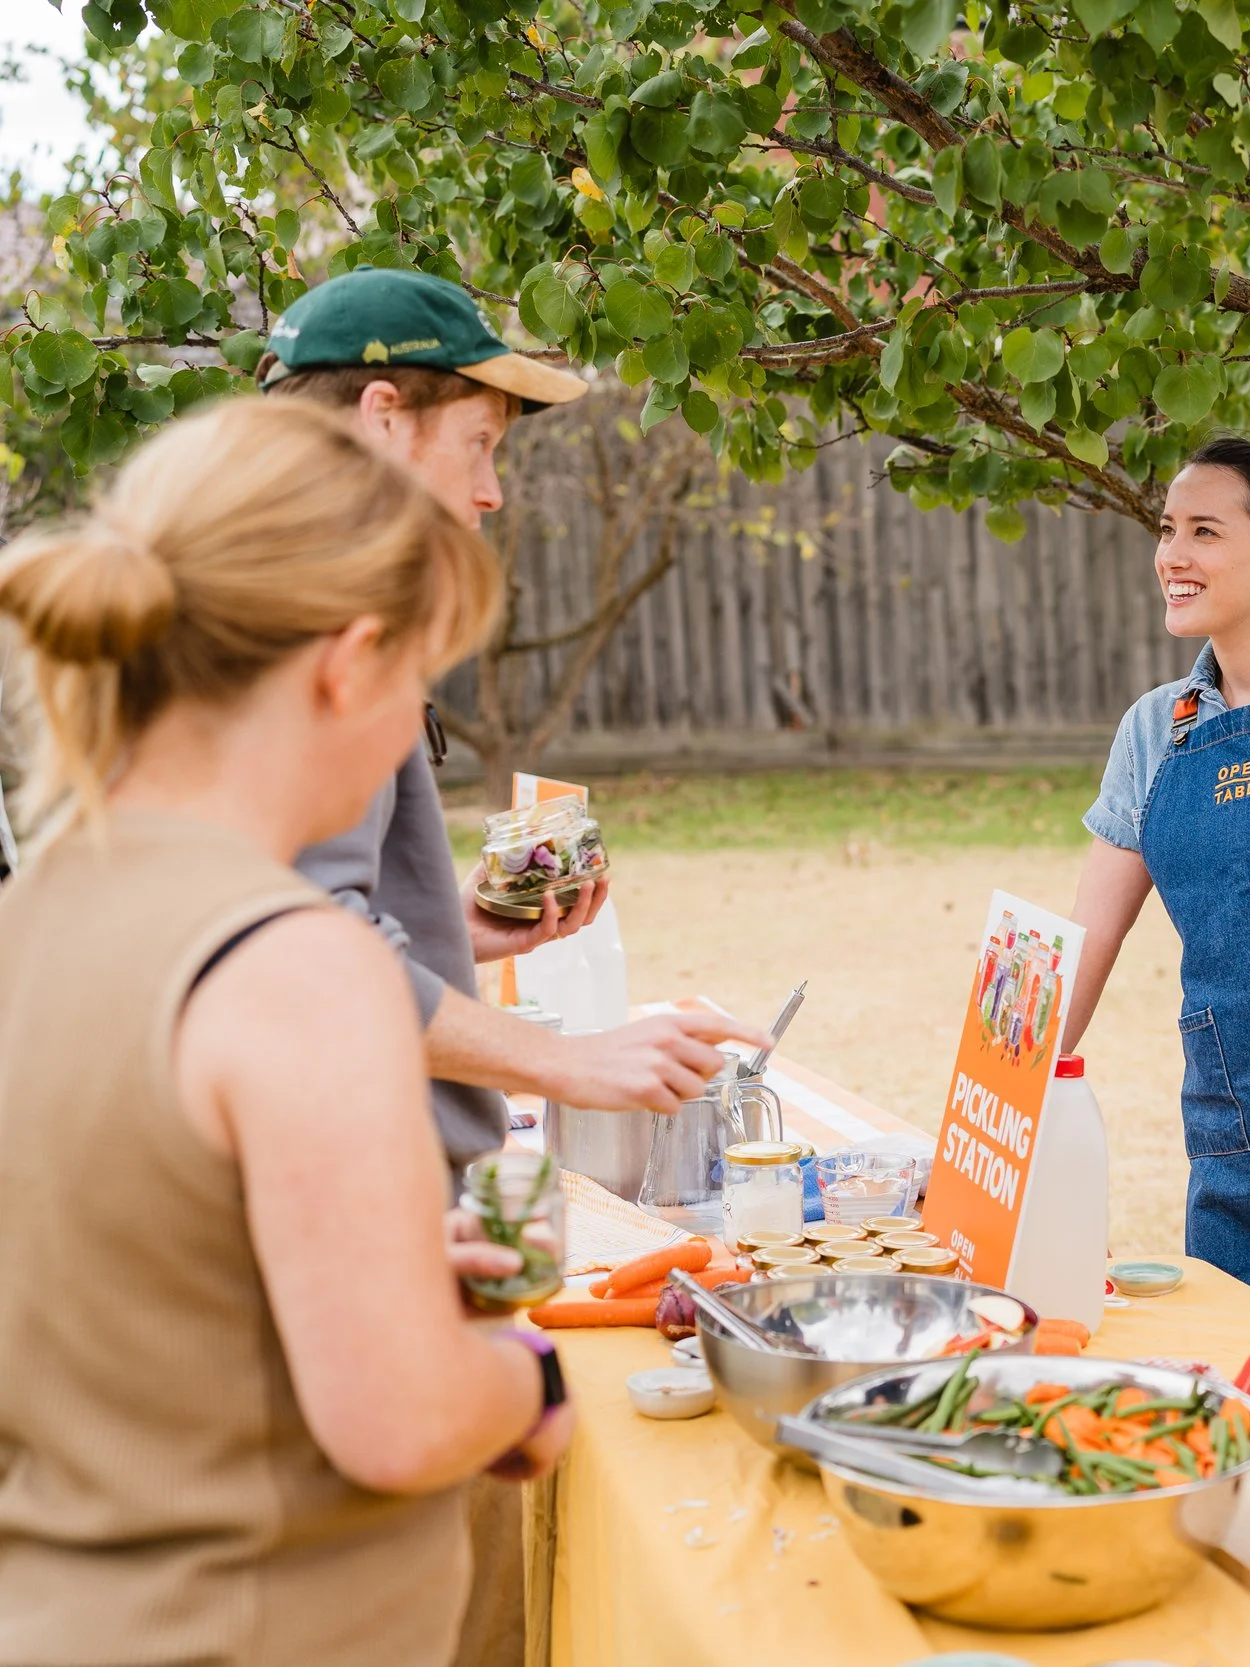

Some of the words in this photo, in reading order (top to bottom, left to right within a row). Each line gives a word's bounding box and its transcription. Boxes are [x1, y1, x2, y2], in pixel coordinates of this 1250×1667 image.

[951, 1071, 1033, 1159] PICKLING
[943, 1122, 1020, 1211] STATION
[950, 1229, 975, 1262] OPEN
